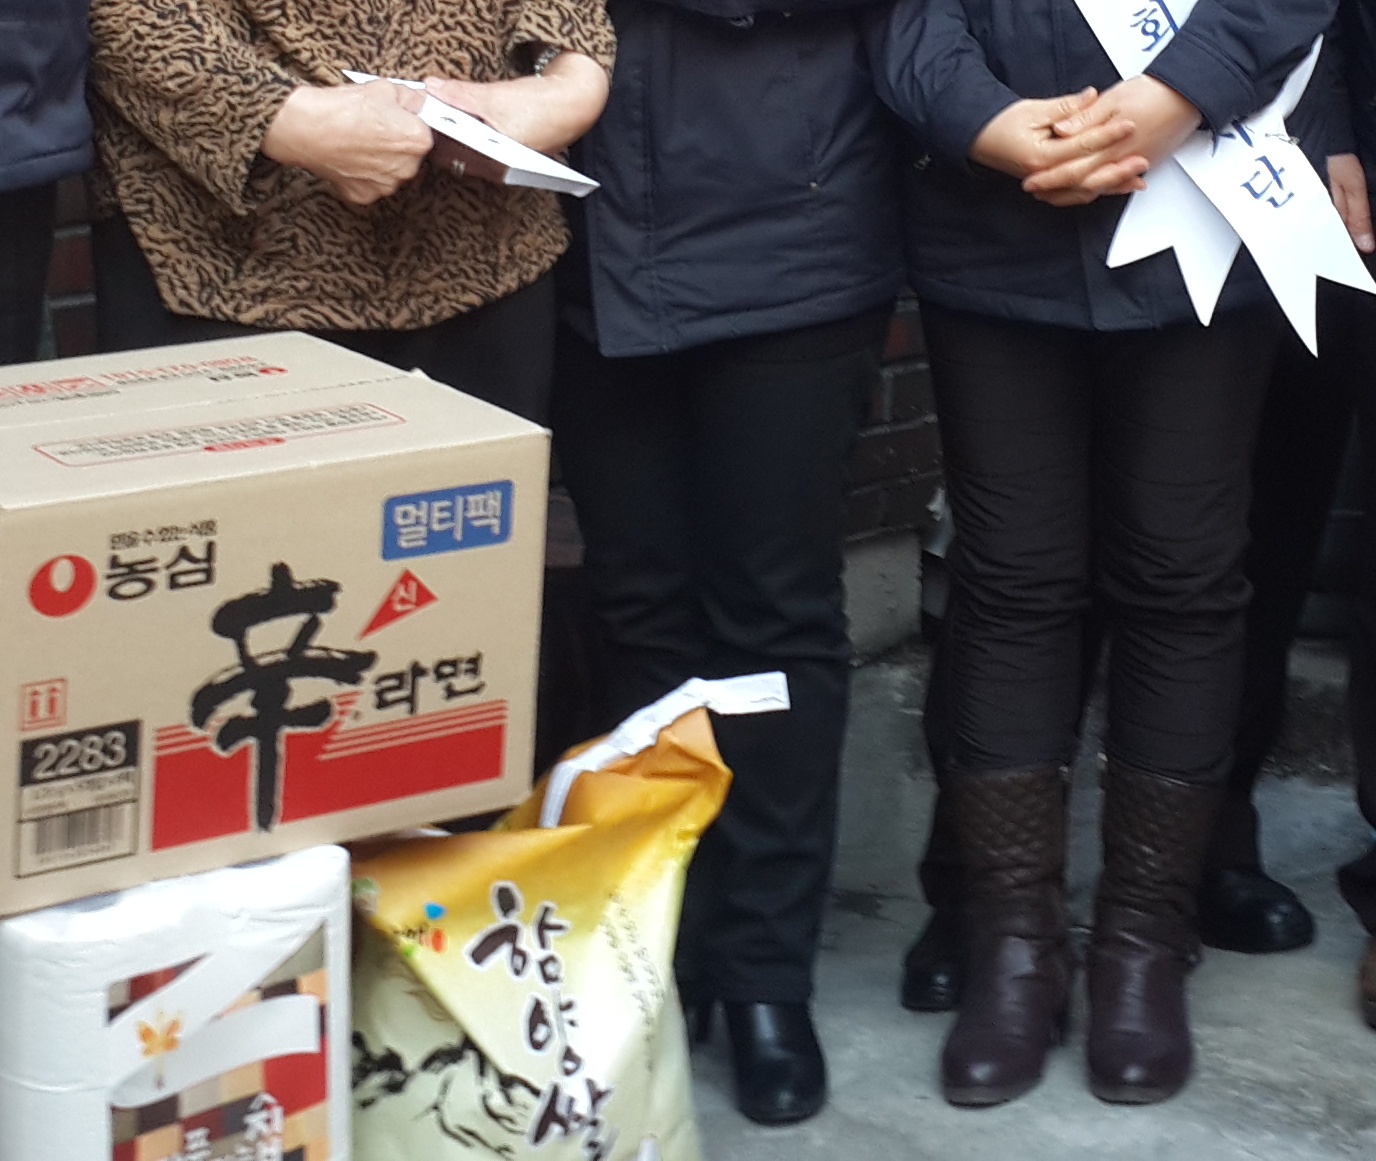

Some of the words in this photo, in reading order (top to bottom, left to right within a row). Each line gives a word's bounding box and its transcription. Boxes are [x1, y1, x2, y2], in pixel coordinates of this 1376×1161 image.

[393, 489, 503, 549] 멀티팩
[105, 540, 217, 601] 농심
[189, 561, 377, 833] 辛
[373, 650, 487, 717] 라면
[33, 730, 127, 779] 2283
